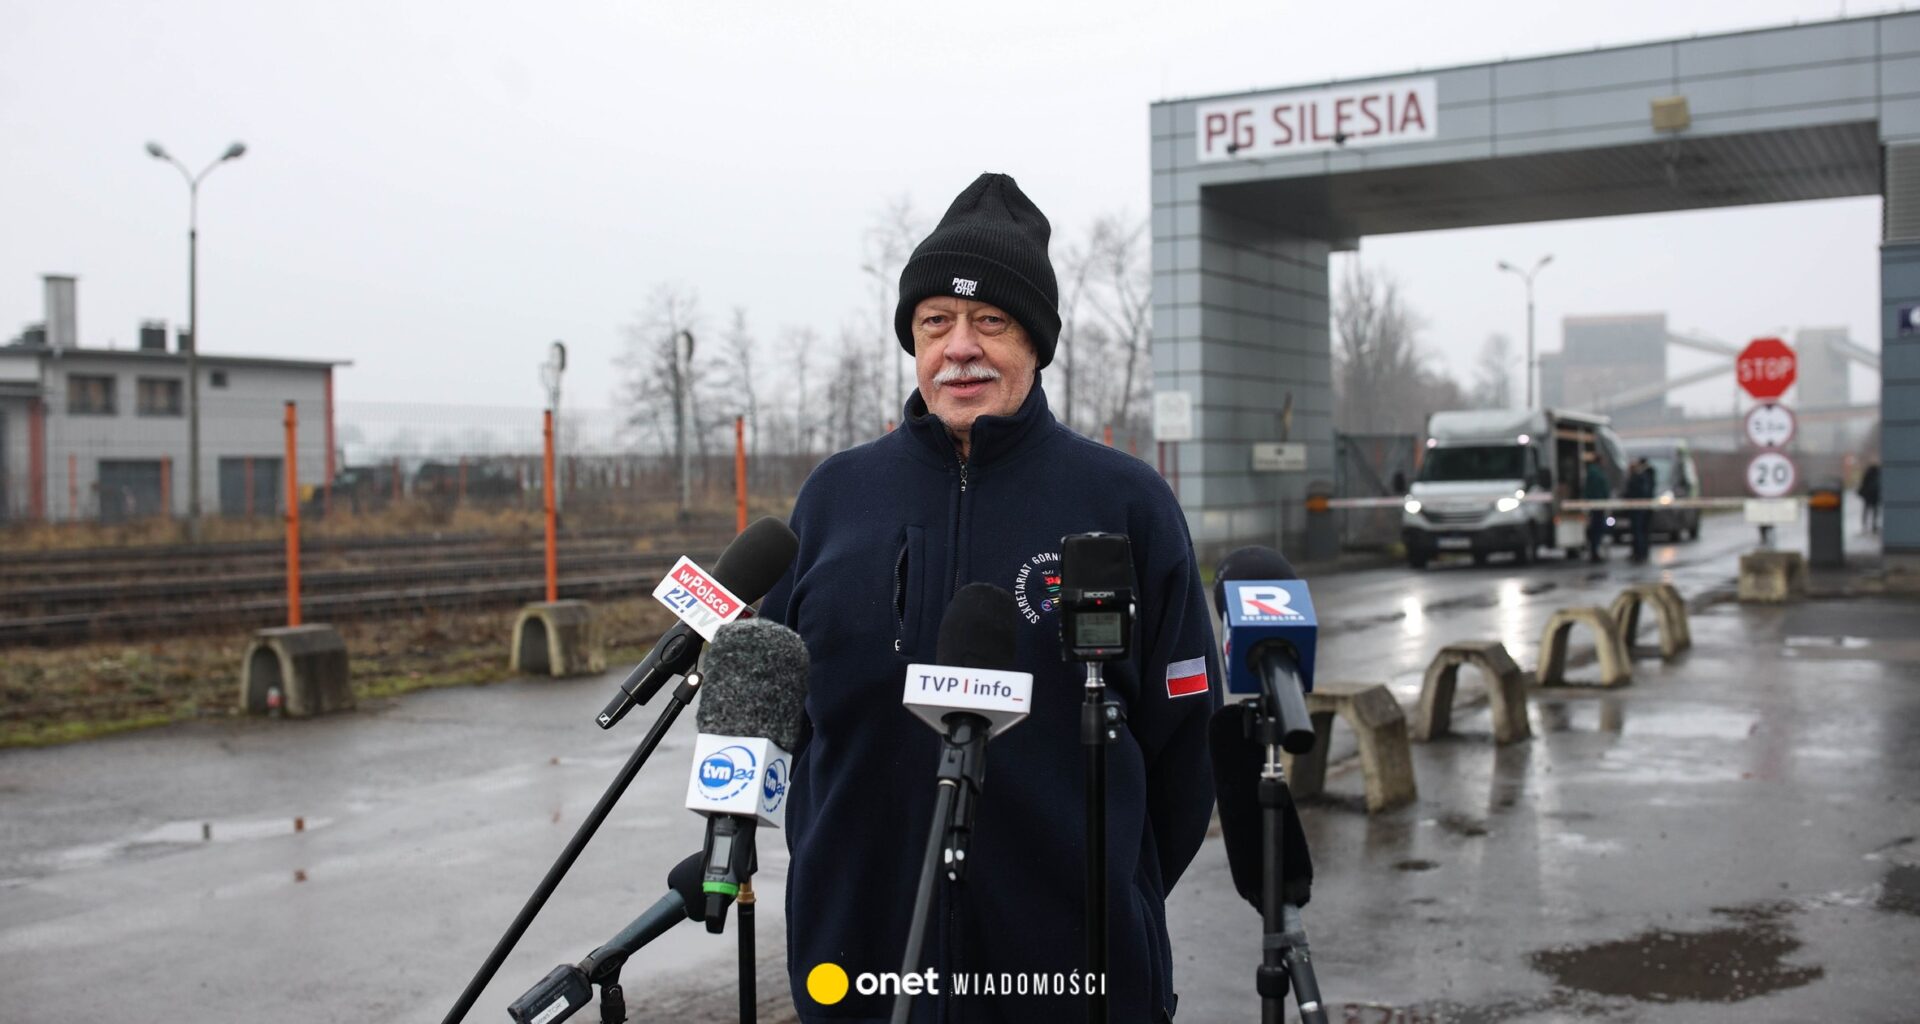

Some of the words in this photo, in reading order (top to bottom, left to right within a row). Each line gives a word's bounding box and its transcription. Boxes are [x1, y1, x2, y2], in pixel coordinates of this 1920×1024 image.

[1205, 110, 1255, 152] PG
[1272, 91, 1426, 146] SILESIA
[1740, 356, 1794, 383] STOP
[1755, 462, 1789, 487] 20
[678, 569, 730, 615] wPolsce
[1014, 563, 1040, 624] SEKRETARIAT
[688, 602, 717, 629] TV
[919, 675, 959, 693] TVP
[703, 761, 732, 780] tvn
